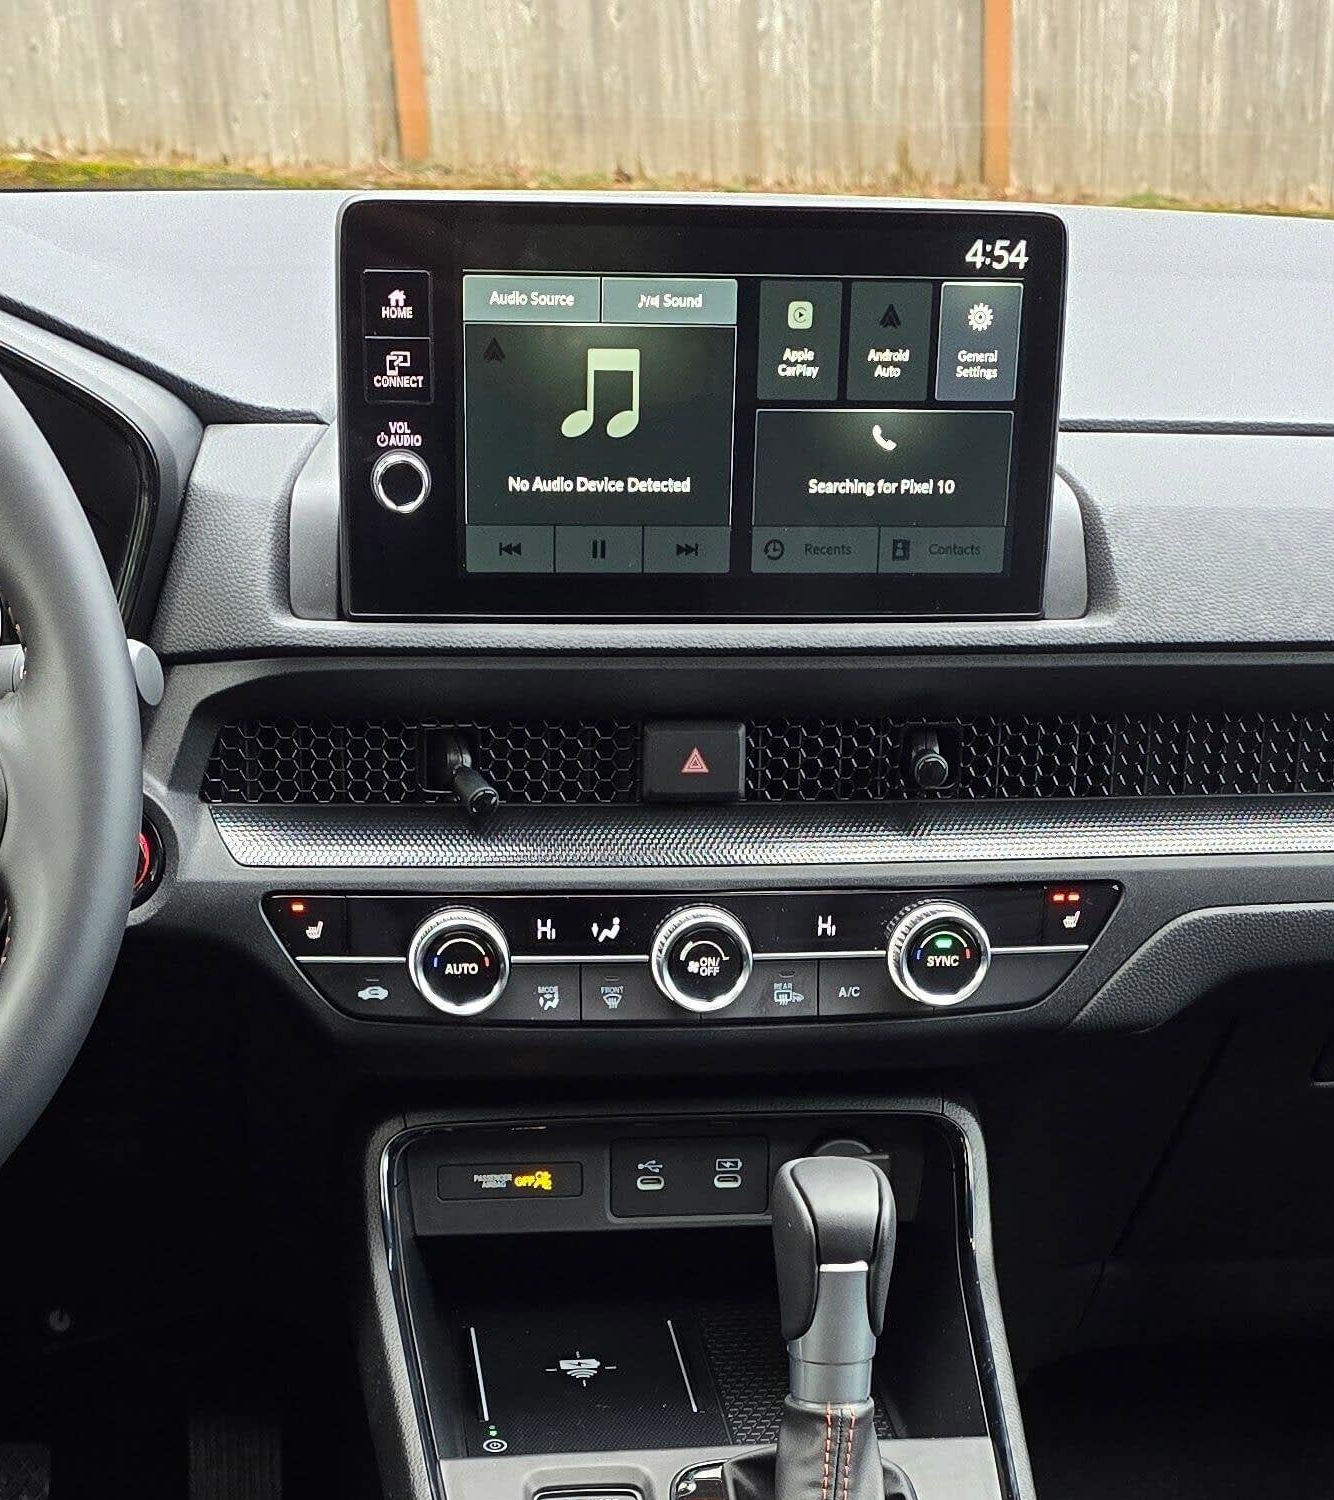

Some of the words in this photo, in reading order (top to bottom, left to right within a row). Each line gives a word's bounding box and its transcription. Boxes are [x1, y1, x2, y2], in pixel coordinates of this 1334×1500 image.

[965, 238, 1029, 270] 4:54
[489, 291, 528, 306] Audio
[531, 292, 575, 307] Source
[663, 293, 703, 308] Sound
[381, 306, 413, 319] HOME
[783, 348, 815, 362] Apple
[867, 349, 910, 362] Android
[957, 350, 998, 363] General
[778, 364, 819, 379] CarPlay
[874, 364, 901, 378] Auto
[955, 365, 998, 380] Settings
[373, 375, 424, 388] CONNECT
[389, 421, 411, 434] VOL
[389, 435, 422, 447] AUDIO
[508, 476, 529, 492] No
[532, 476, 574, 492] Audio
[576, 476, 624, 492] Device
[627, 477, 691, 493] Detected
[808, 478, 875, 497] Searching
[877, 479, 898, 495] for
[900, 479, 933, 495] Pixel
[937, 479, 956, 495] 10
[805, 543, 852, 556] Recents
[928, 543, 981, 556] Contacts
[926, 955, 960, 967] SYNC
[444, 962, 479, 975] AUTO
[699, 967, 720, 977] OFF
[538, 985, 559, 994] MODE
[600, 986, 624, 994] FRONT
[773, 982, 793, 991] REAR
[838, 987, 860, 998] A/C
[514, 1175, 535, 1187] OFF
